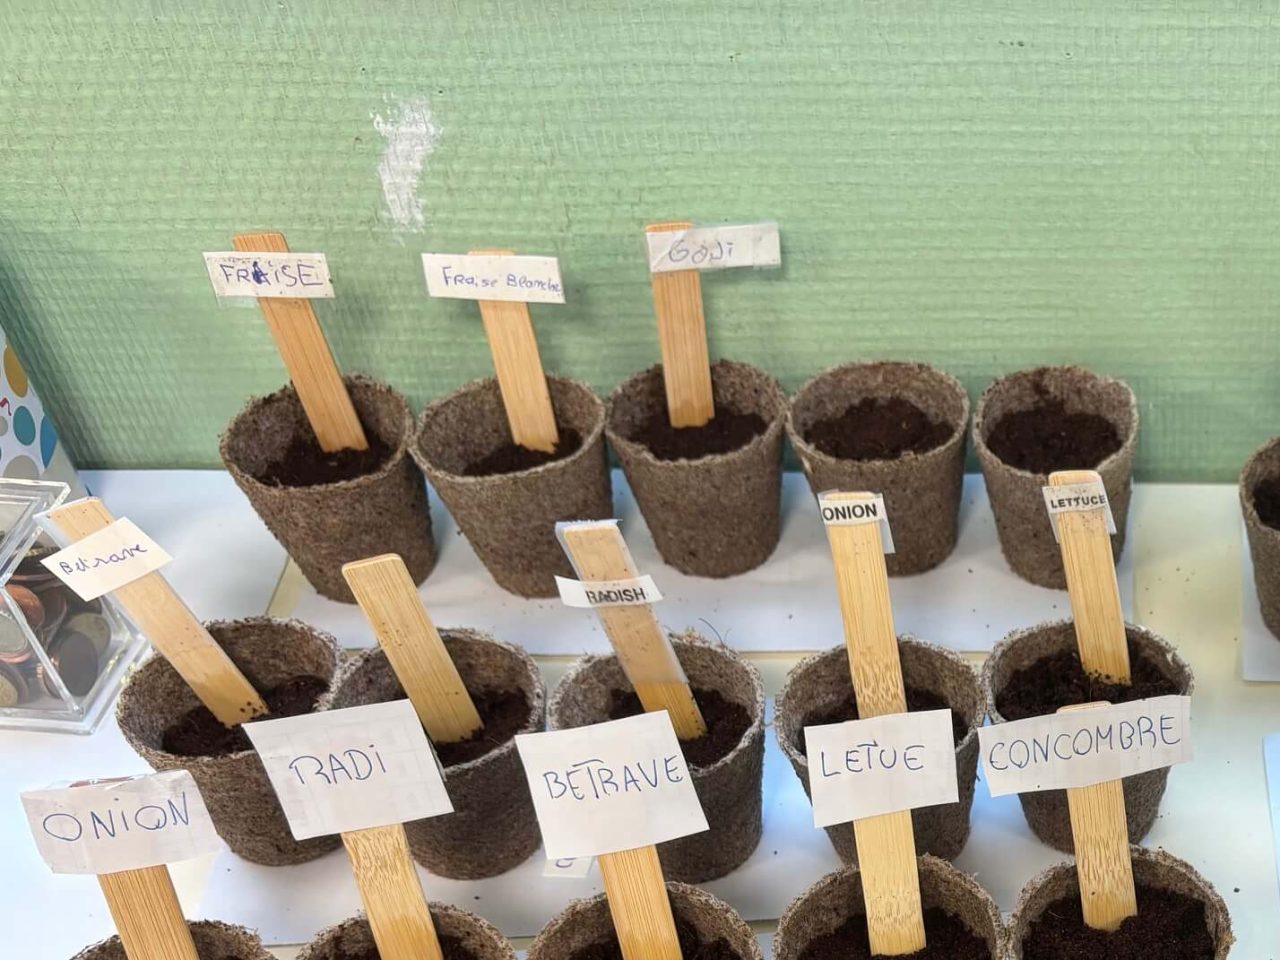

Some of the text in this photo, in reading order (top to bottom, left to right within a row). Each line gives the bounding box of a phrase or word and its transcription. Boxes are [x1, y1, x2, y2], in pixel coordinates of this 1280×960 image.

[822, 502, 878, 521] ONION
[1050, 493, 1107, 509] LETTUCE
[585, 587, 648, 604] RADISH
[821, 733, 926, 778] LETUE
[988, 711, 1183, 775] CONCOMBRE
[542, 754, 685, 802] BETRAVE
